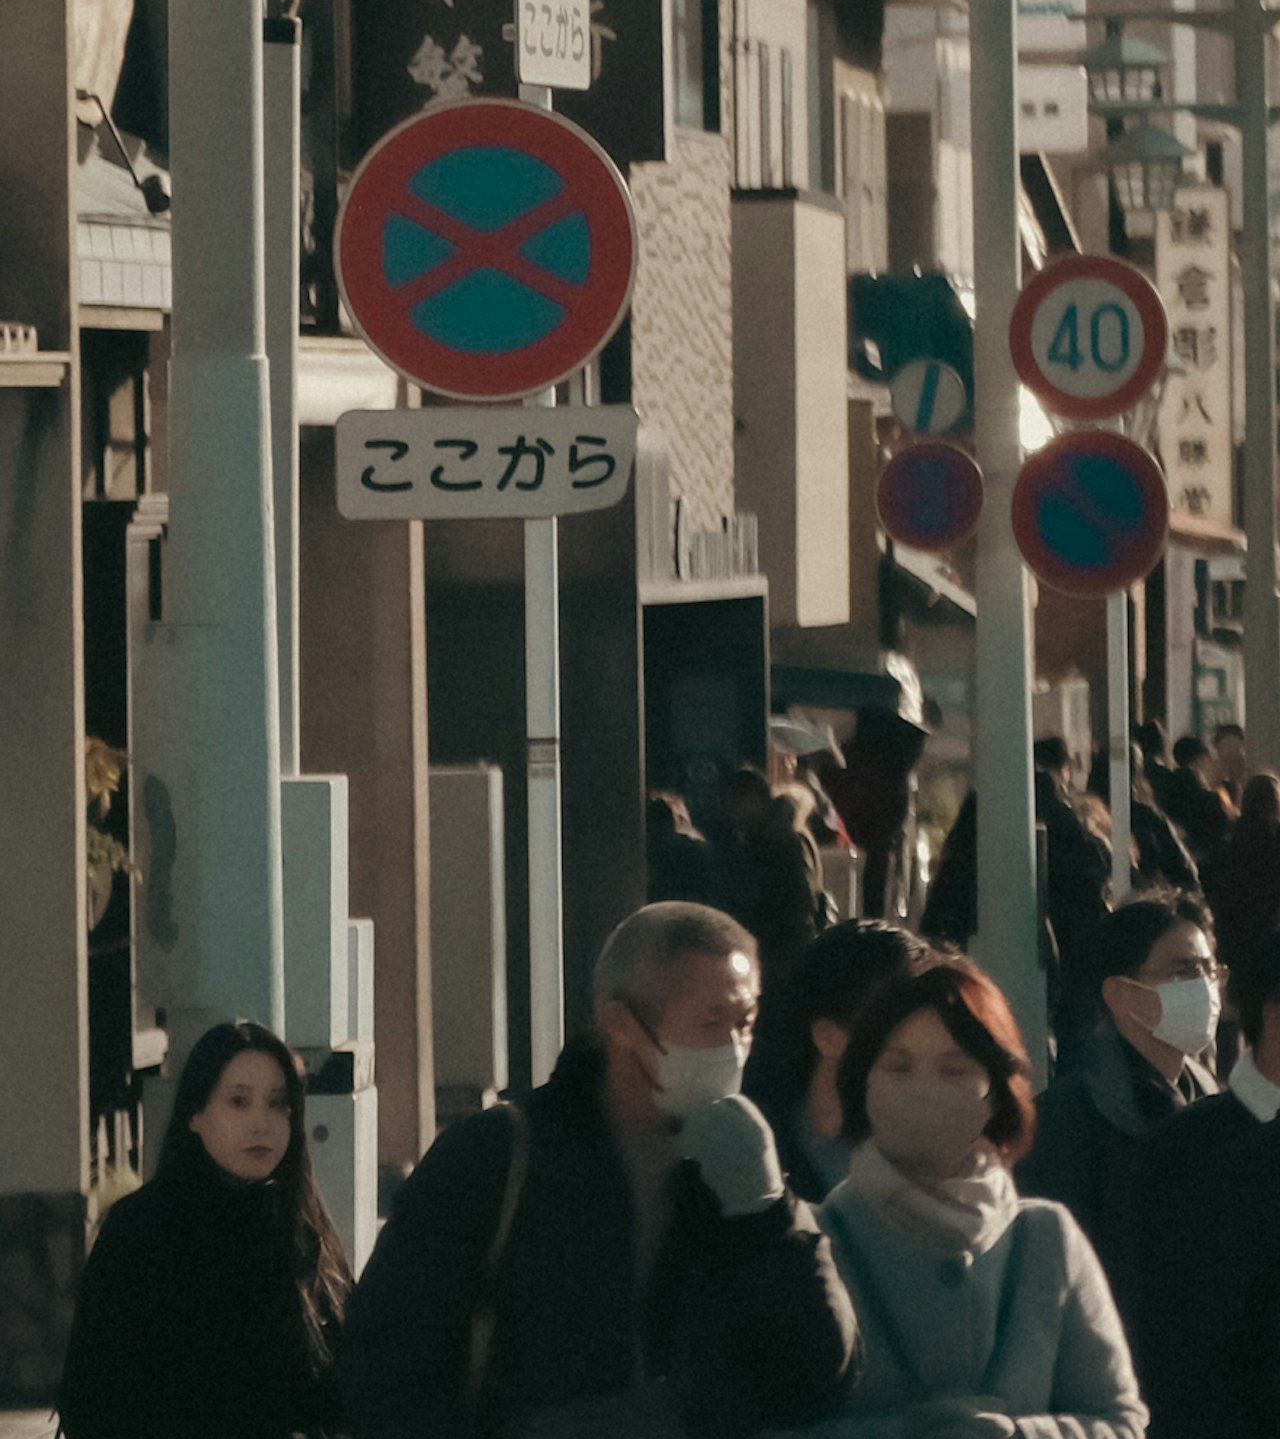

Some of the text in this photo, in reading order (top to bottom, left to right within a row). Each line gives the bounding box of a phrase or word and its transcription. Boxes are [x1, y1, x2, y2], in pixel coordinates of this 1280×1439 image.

[523, 1, 586, 62] ここから
[1047, 302, 1131, 375] 40
[359, 433, 618, 493] ここから
